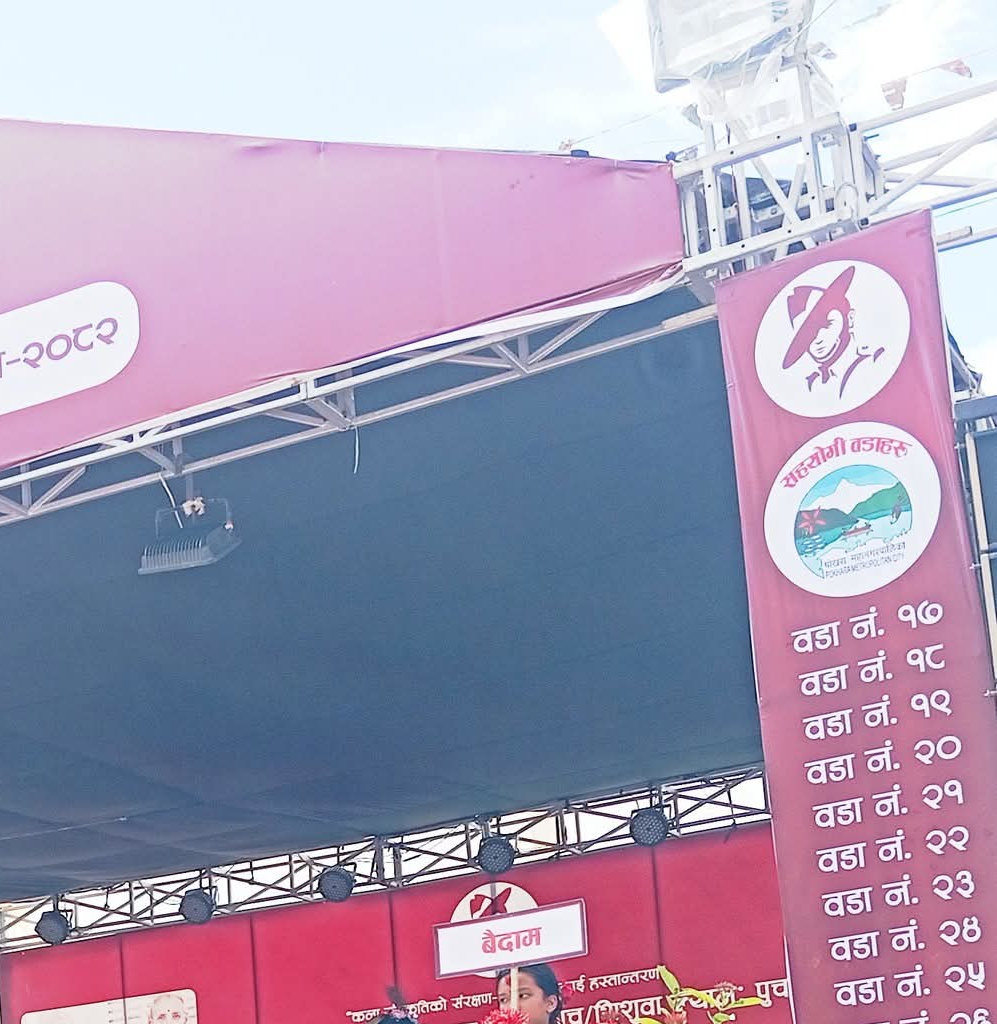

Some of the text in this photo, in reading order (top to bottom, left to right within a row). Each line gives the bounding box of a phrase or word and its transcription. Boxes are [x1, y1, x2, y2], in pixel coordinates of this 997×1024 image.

[791, 600, 943, 653] वडा नं. १७
[798, 644, 945, 696] वडा नं. १८
[804, 735, 962, 784] वडा नं. २०
[821, 870, 975, 917] वडा नं. २३
[481, 925, 543, 955] बैदाम
